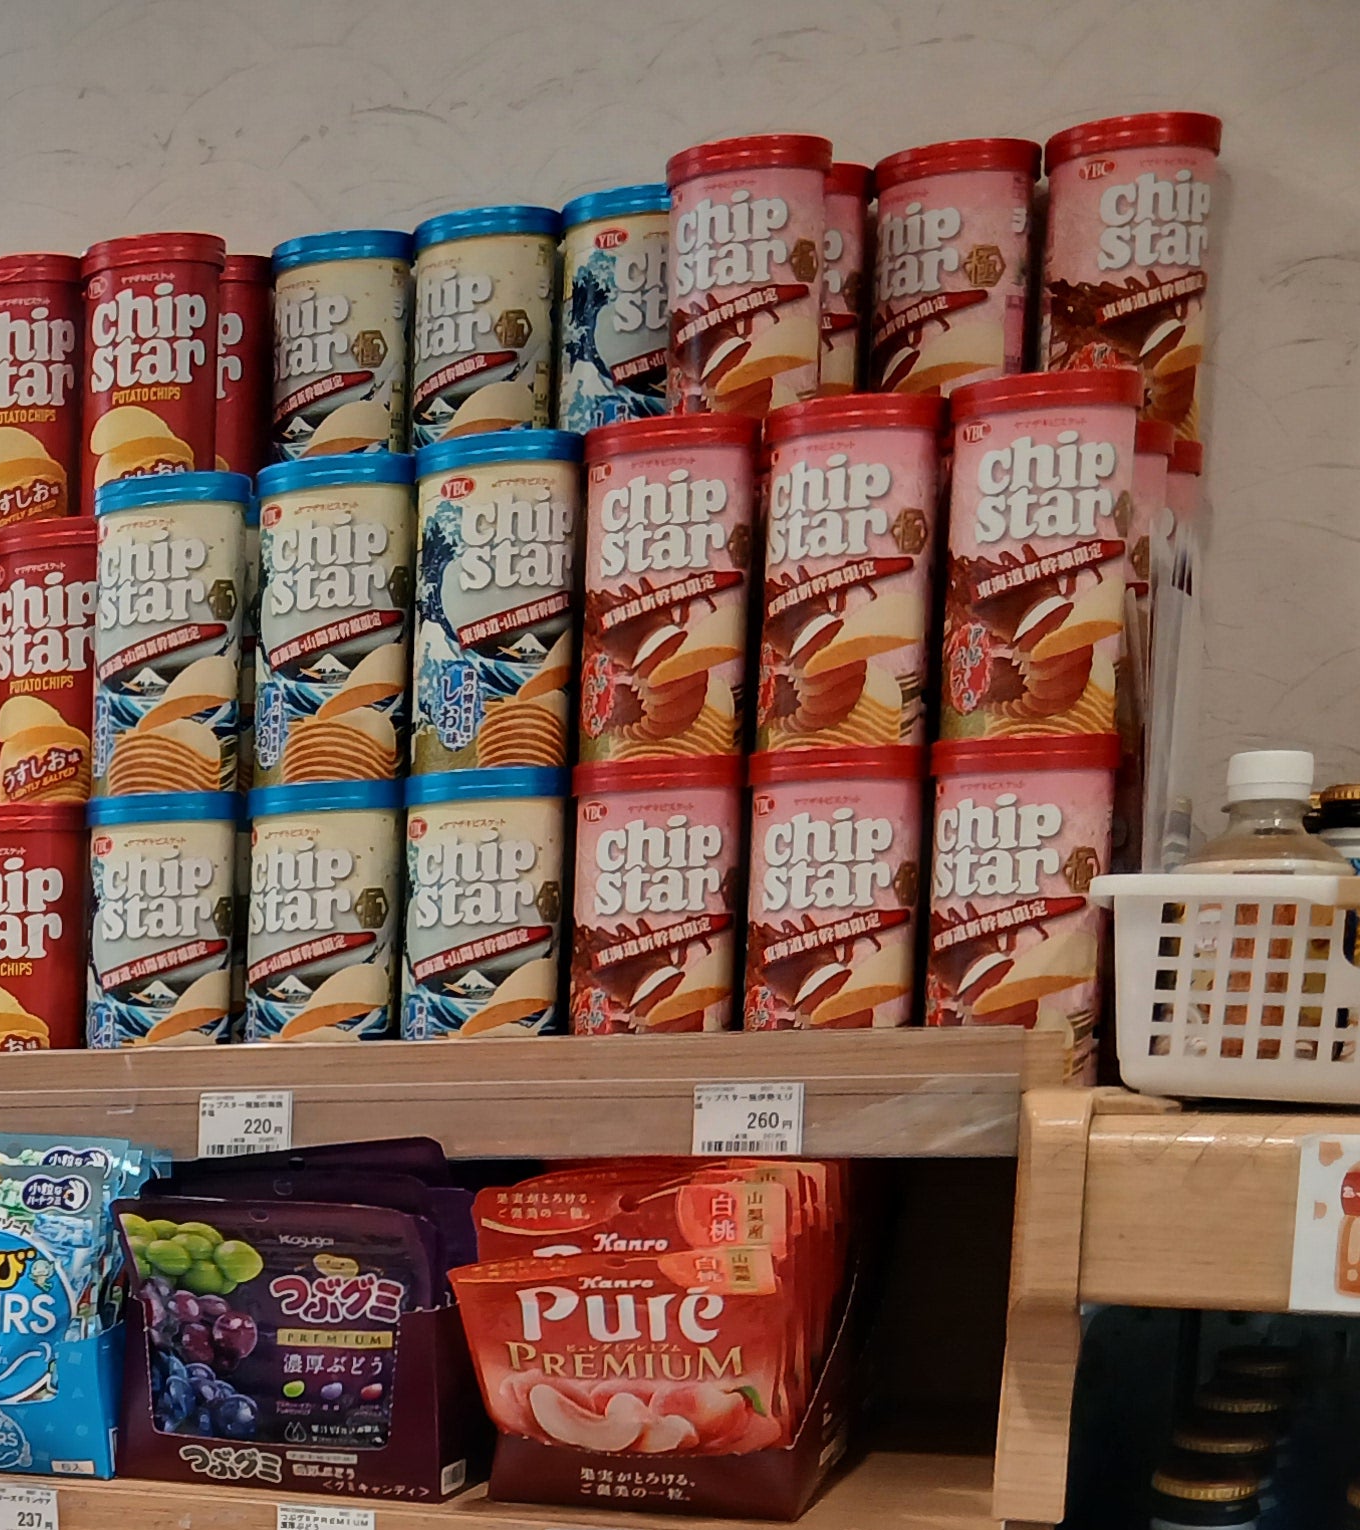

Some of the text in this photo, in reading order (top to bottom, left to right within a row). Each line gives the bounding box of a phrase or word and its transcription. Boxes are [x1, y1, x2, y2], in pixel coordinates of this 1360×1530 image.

[91, 281, 207, 347] chip
[91, 336, 207, 394] star
[112, 386, 182, 405] POTATO CHIPS
[979, 430, 1117, 496] chip
[445, 480, 474, 498] YBC
[601, 468, 727, 533] chip
[975, 488, 1115, 544] star
[271, 513, 388, 573] chip
[600, 522, 727, 578] star
[270, 562, 387, 617] star
[417, 827, 536, 887] chip
[595, 815, 723, 873] chip
[763, 806, 894, 866] chip
[415, 879, 535, 930] star
[593, 865, 720, 917] star
[762, 859, 892, 911] star
[1, 961, 33, 977] CHIPS
[243, 1118, 283, 1135] 220円
[747, 1111, 793, 1130] 260円
[28, 1181, 63, 1196] 小粒な
[592, 1233, 669, 1252] Kanro
[708, 1194, 736, 1243] 白桃
[270, 1273, 405, 1323] つぶグミ
[282, 1352, 384, 1375] 濃厚ぶどう
[286, 1332, 383, 1347] PREMIUM
[505, 1340, 744, 1380] PREMIUM
[580, 1467, 697, 1488] 果実がとろける。
[17, 1512, 53, 1530] 237円
